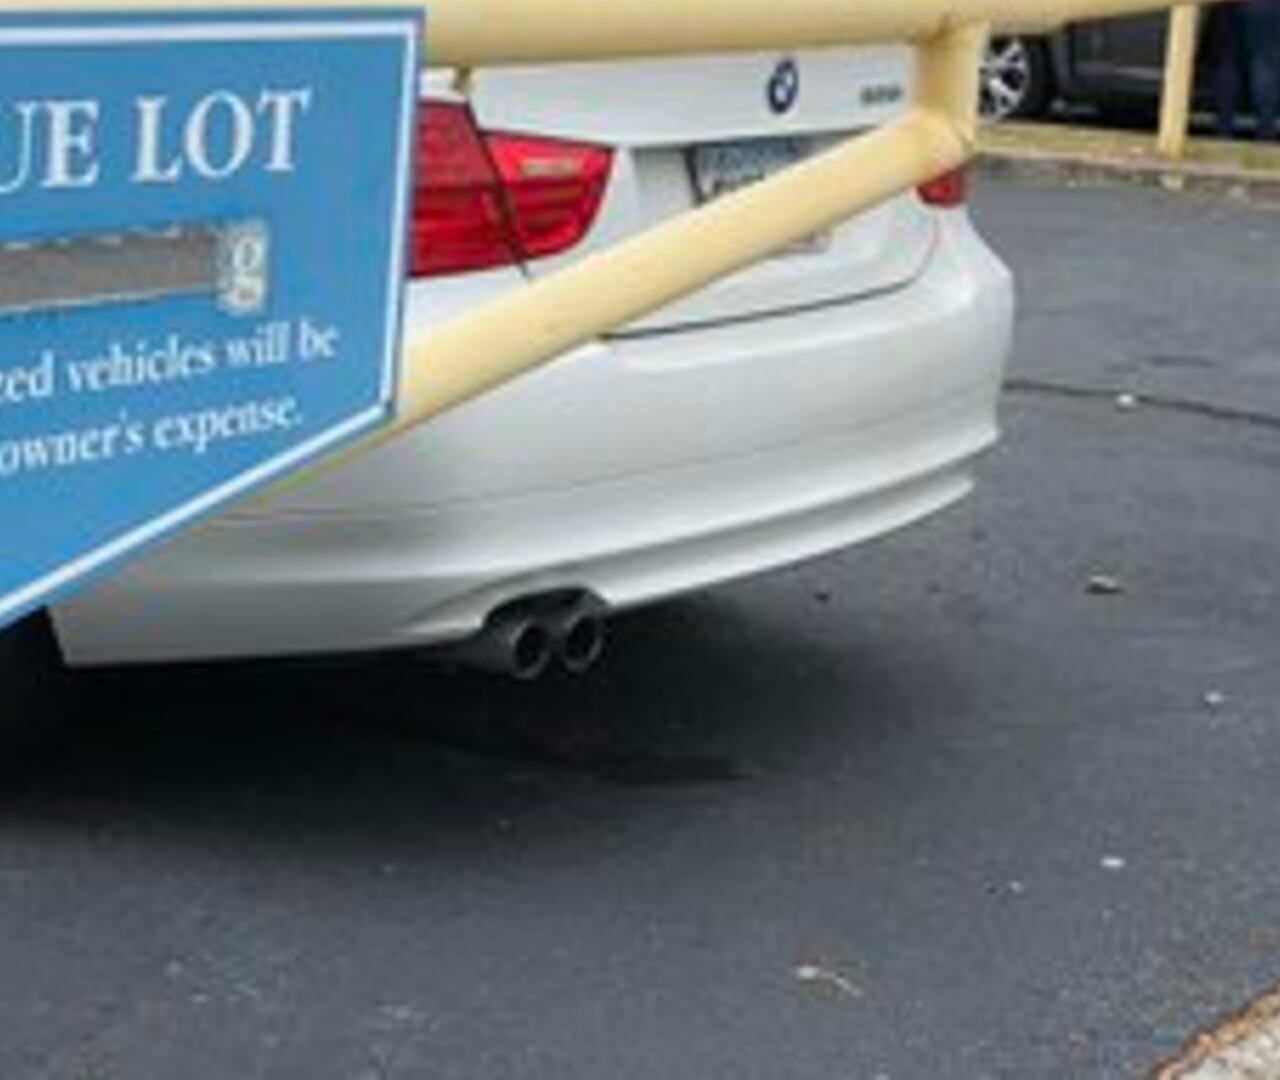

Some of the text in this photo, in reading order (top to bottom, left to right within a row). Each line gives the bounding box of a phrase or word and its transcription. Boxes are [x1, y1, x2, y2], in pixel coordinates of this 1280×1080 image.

[130, 88, 312, 183] LOT
[67, 334, 216, 392] vehicles
[227, 320, 290, 367] will
[298, 318, 339, 361] be
[153, 394, 303, 454] expense.
